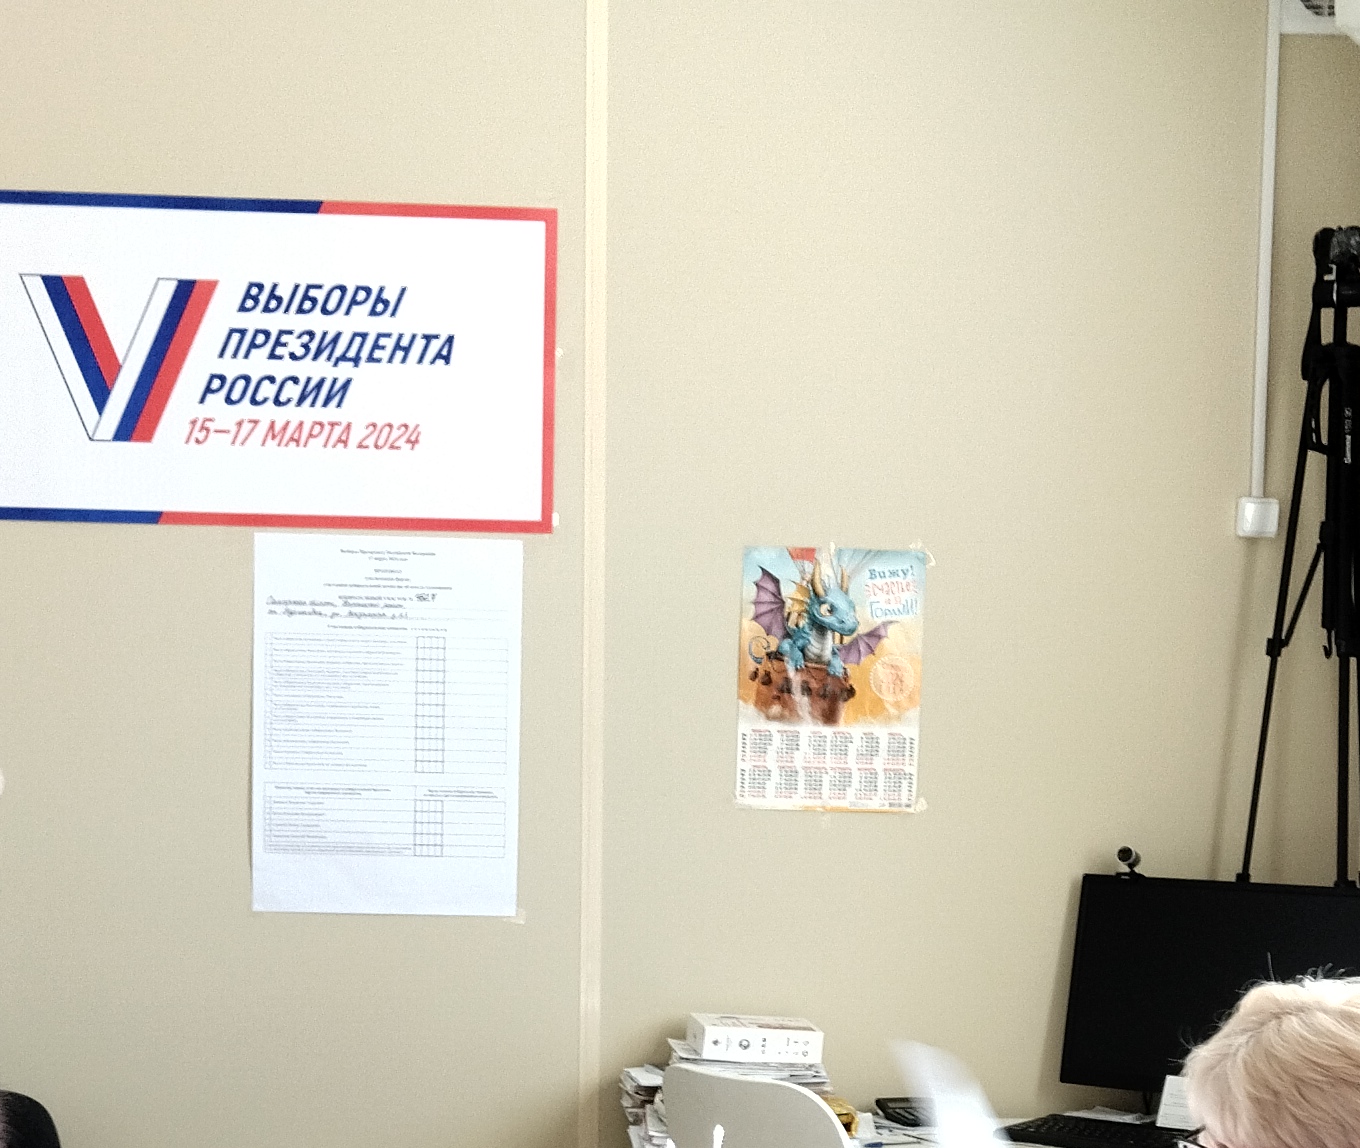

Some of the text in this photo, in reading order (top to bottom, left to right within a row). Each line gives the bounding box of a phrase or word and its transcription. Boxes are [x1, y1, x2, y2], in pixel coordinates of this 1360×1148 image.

[236, 281, 408, 319] ВЫБОРЫ
[216, 327, 456, 369] ПРЕЗИДЕНТА
[197, 373, 354, 409] РОССИИ
[185, 417, 422, 451] 15–17 МАРТА 2024
